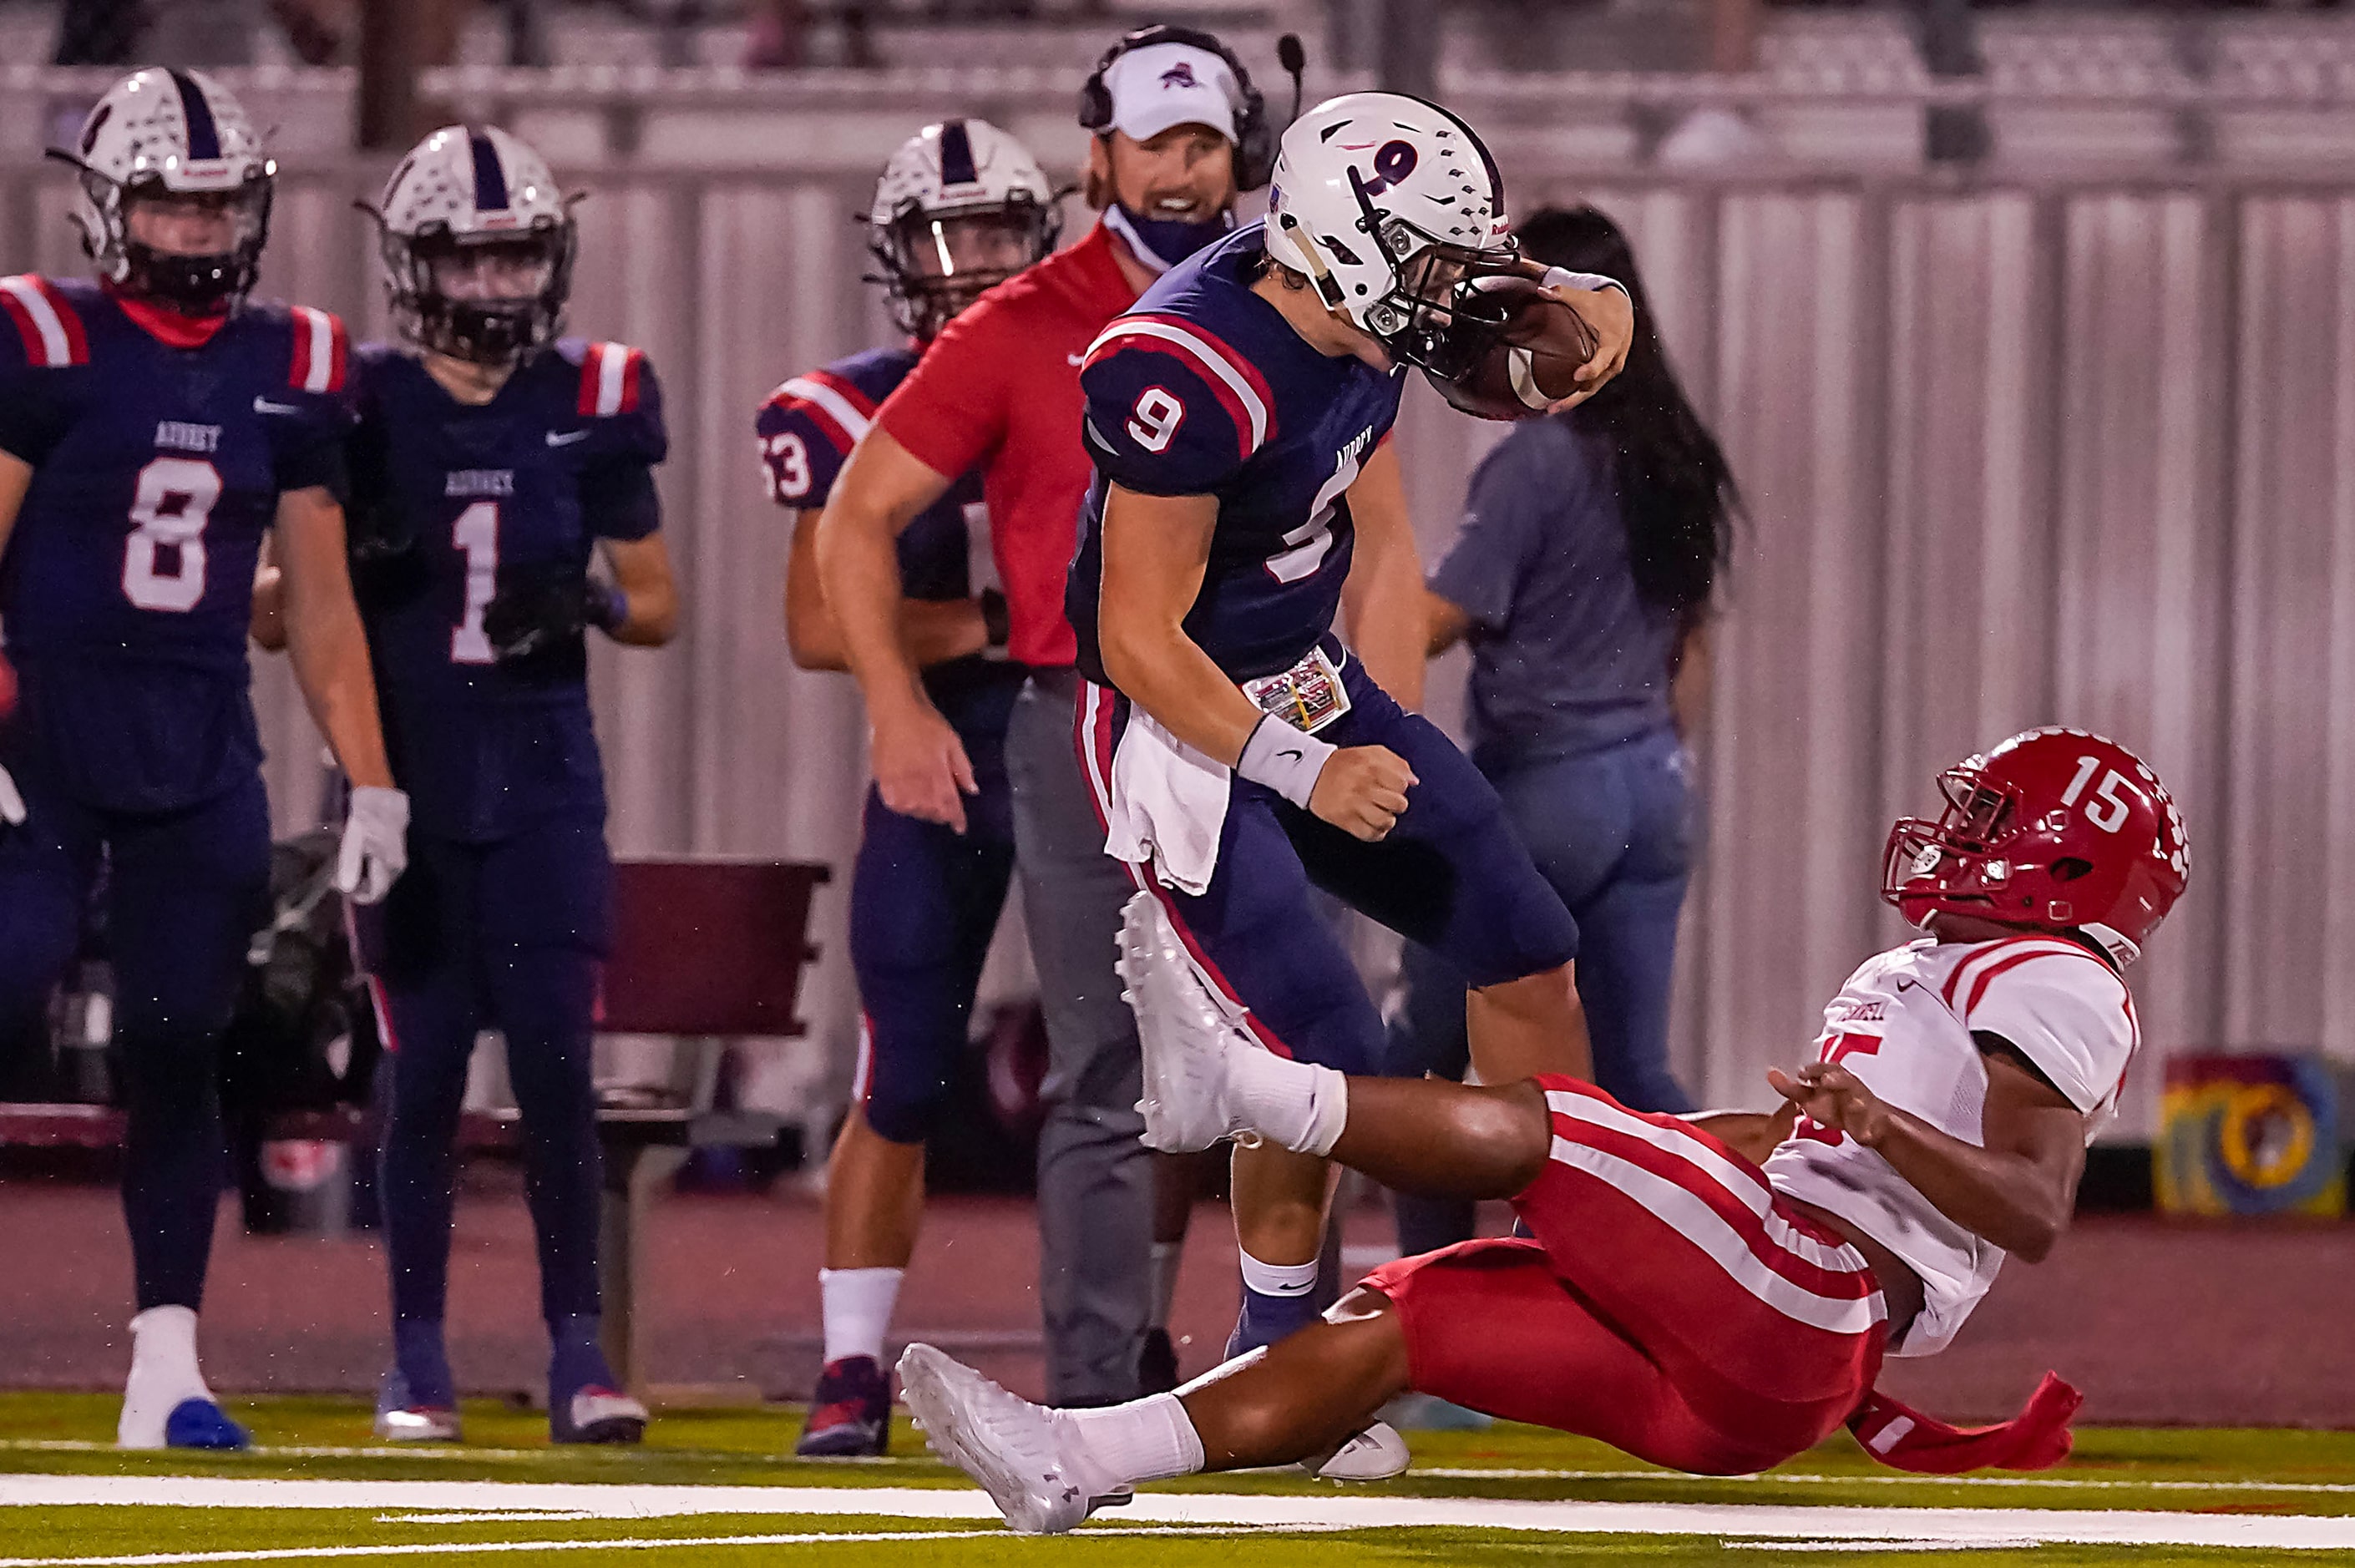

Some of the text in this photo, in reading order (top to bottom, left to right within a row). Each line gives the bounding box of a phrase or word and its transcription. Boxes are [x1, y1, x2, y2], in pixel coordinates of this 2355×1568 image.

[1124, 385, 1187, 454] 9
[121, 457, 224, 613] 8
[451, 502, 499, 665] 1
[2060, 756, 2144, 833] 15
